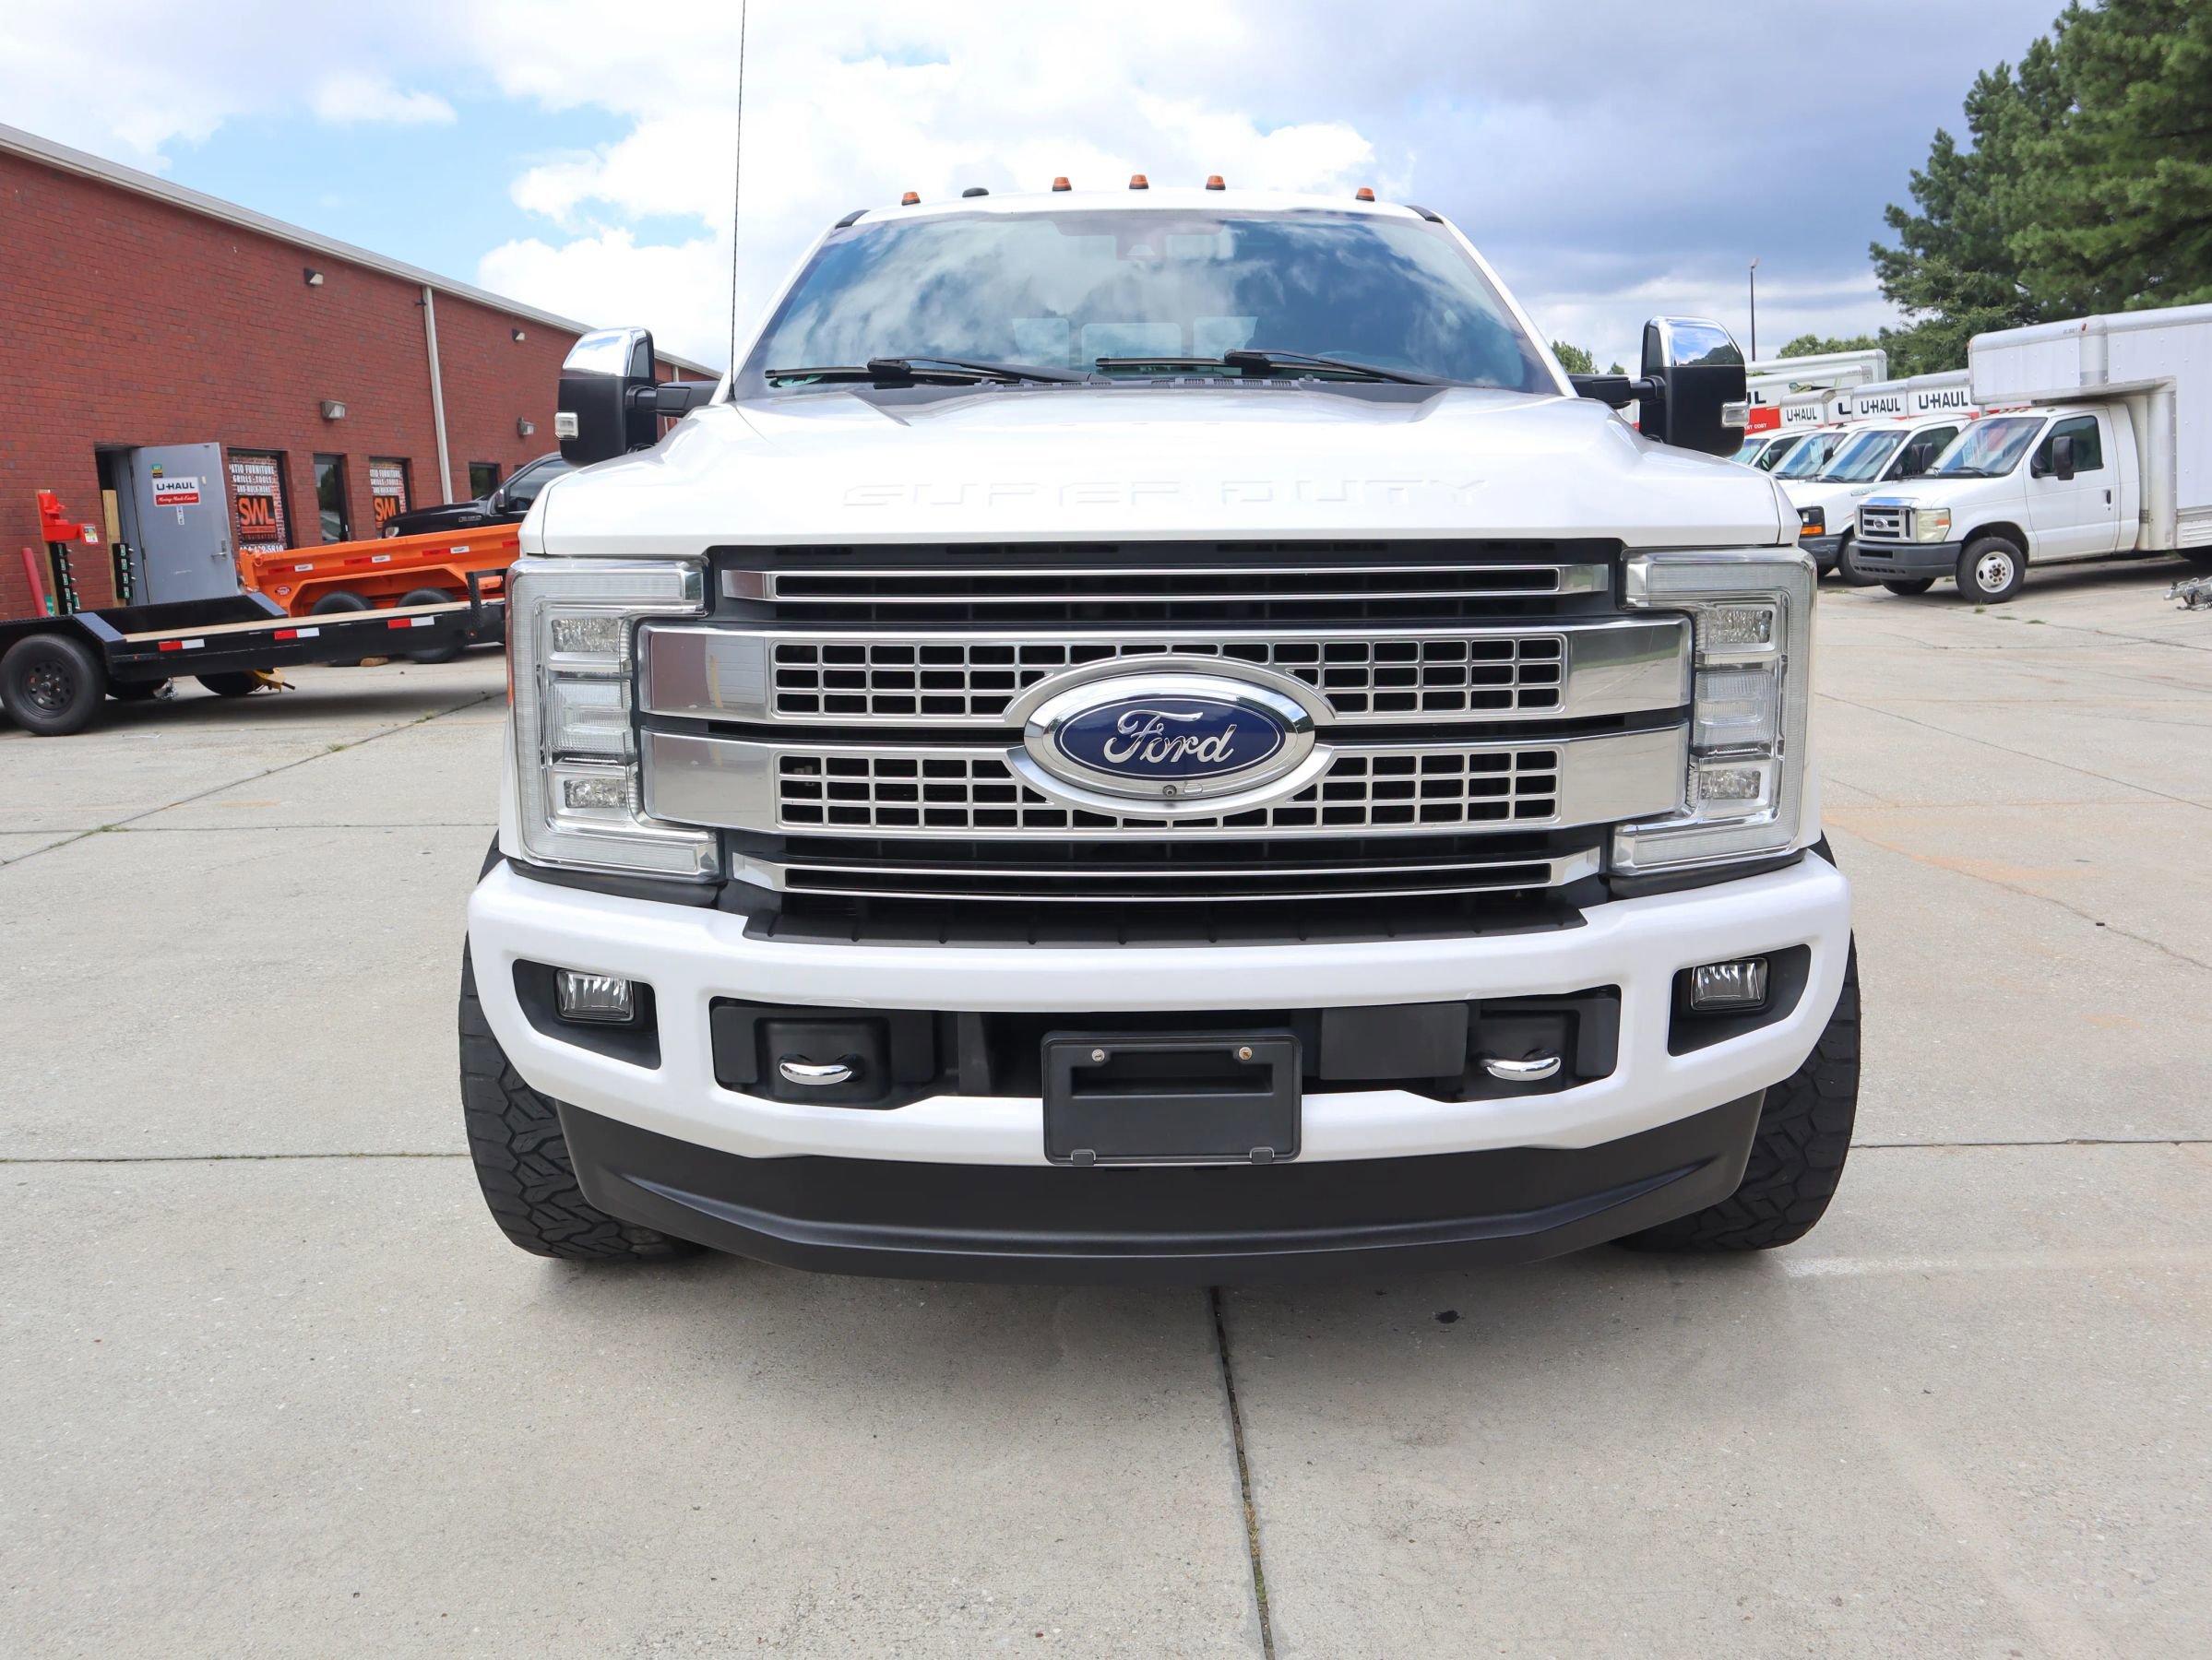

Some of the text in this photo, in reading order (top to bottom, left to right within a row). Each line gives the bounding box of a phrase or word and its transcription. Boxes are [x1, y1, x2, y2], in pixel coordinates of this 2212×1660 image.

[1861, 397, 1901, 414] U-HAUL
[1918, 390, 1968, 409] U-HAUL
[1786, 407, 1818, 422] U-HAUL
[156, 481, 196, 491] U-HAUL
[841, 479, 1492, 508] SUPER DUTY
[238, 497, 275, 526] SWL
[1103, 709, 1238, 764] Ford
